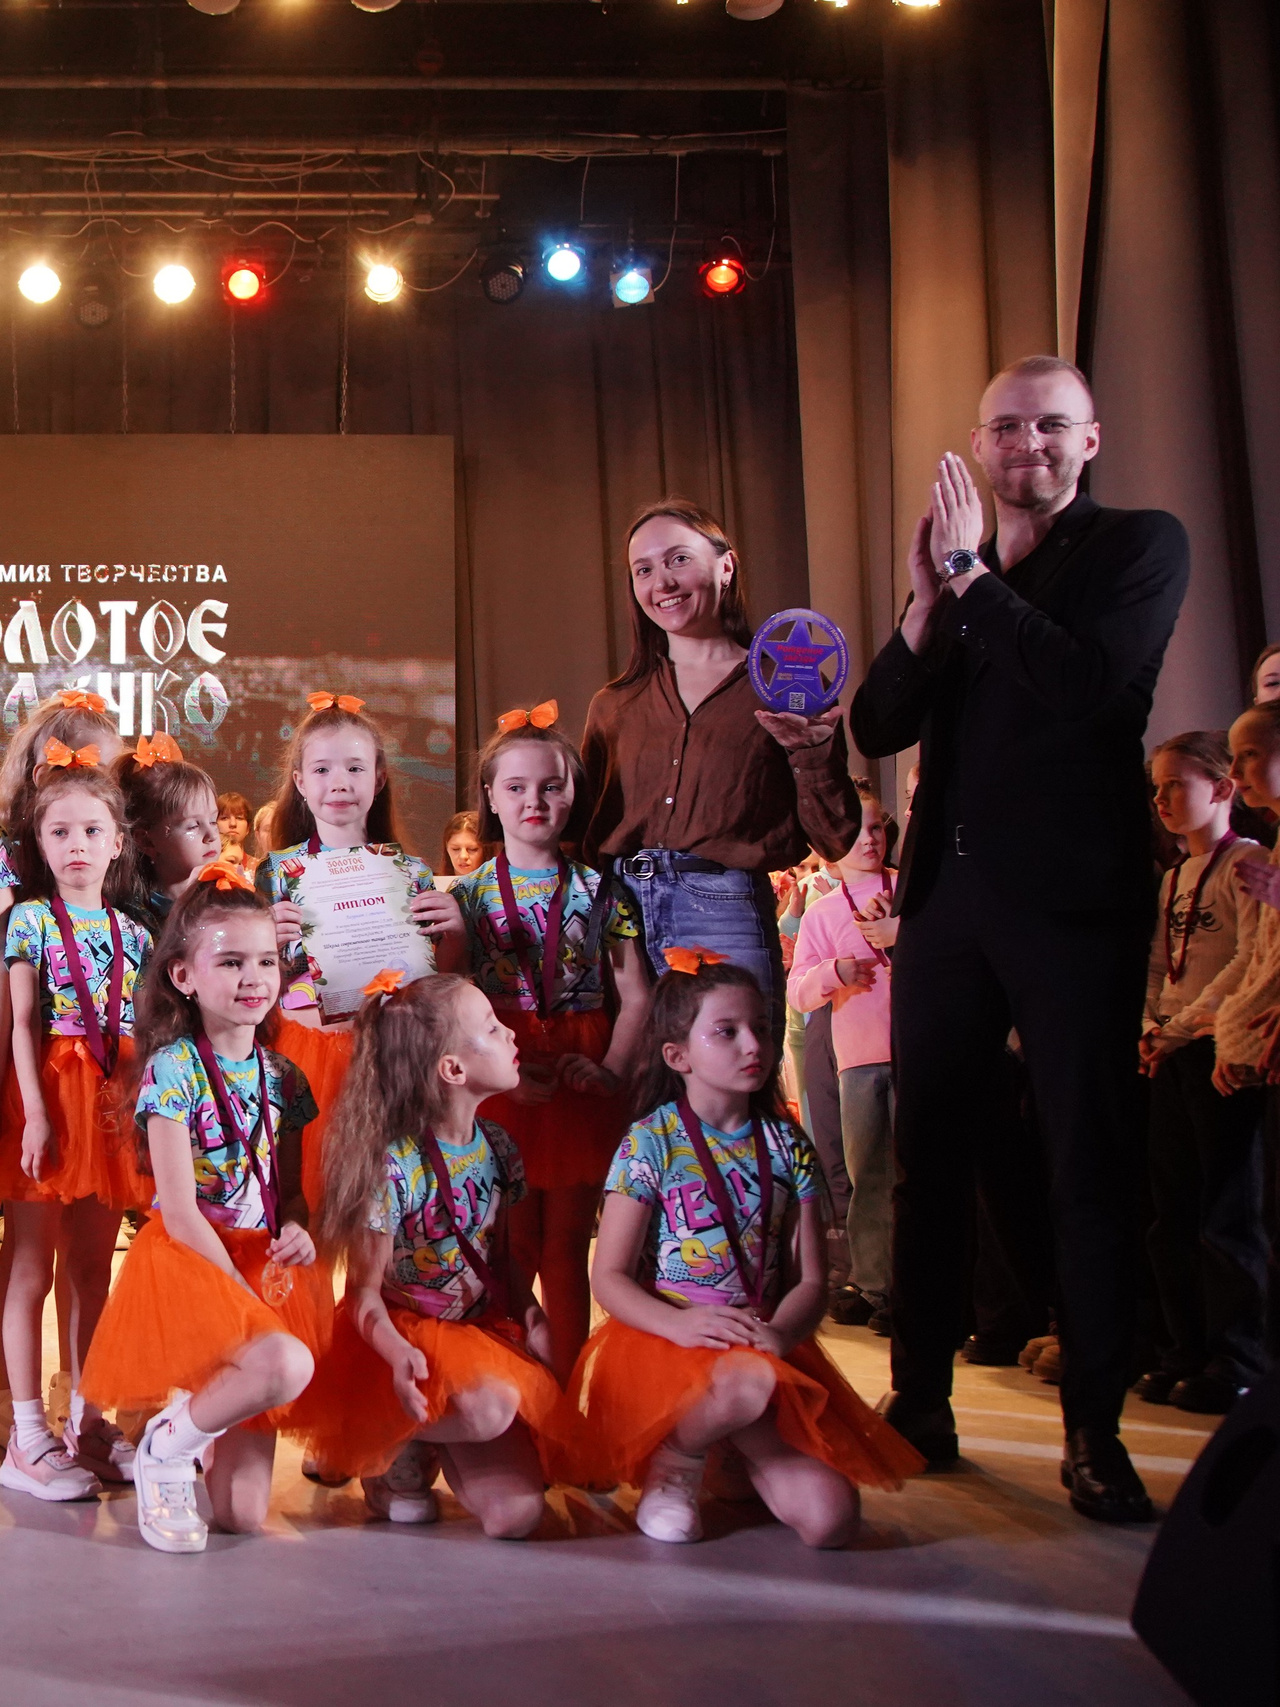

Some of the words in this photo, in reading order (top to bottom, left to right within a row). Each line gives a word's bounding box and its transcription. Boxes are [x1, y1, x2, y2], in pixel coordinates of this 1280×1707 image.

[60, 564, 228, 583] ТВОРЧЕСТВА
[326, 857, 362, 868] ЗОЛОТОЕ
[328, 864, 365, 875] ЯБЛОЧКО
[333, 896, 385, 912] ДИПЛОМ
